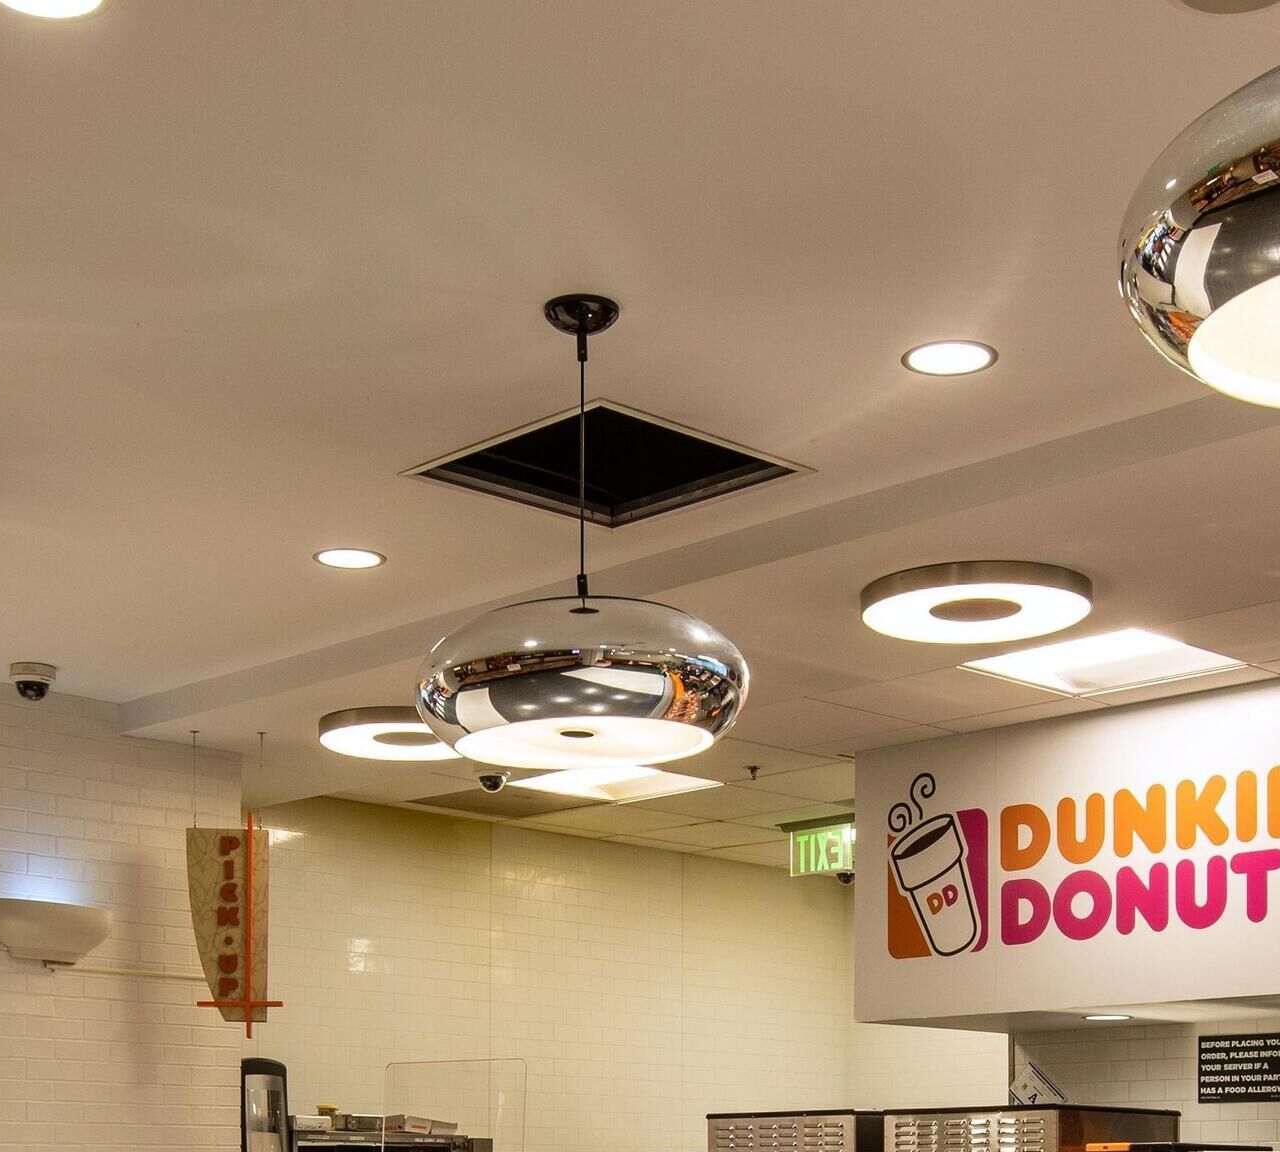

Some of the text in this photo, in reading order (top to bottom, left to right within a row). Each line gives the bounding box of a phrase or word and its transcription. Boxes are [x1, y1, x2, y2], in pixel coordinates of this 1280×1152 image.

[927, 883, 959, 915] DD
[1202, 1040, 1230, 1049] BEFORE
[1231, 1039, 1265, 1048] PLACING
[1201, 1051, 1228, 1060] ORDER,
[1230, 1050, 1258, 1058] PLEASE
[1201, 1062, 1269, 1071] YOUR SERVER IF A
[1200, 1074, 1230, 1082] PERSON
[1232, 1074, 1240, 1082] IN
[1240, 1074, 1262, 1082] YOUR
[1200, 1086, 1216, 1094] HAS
[1216, 1086, 1224, 1094] A
[1225, 1086, 1247, 1094] FOOD
